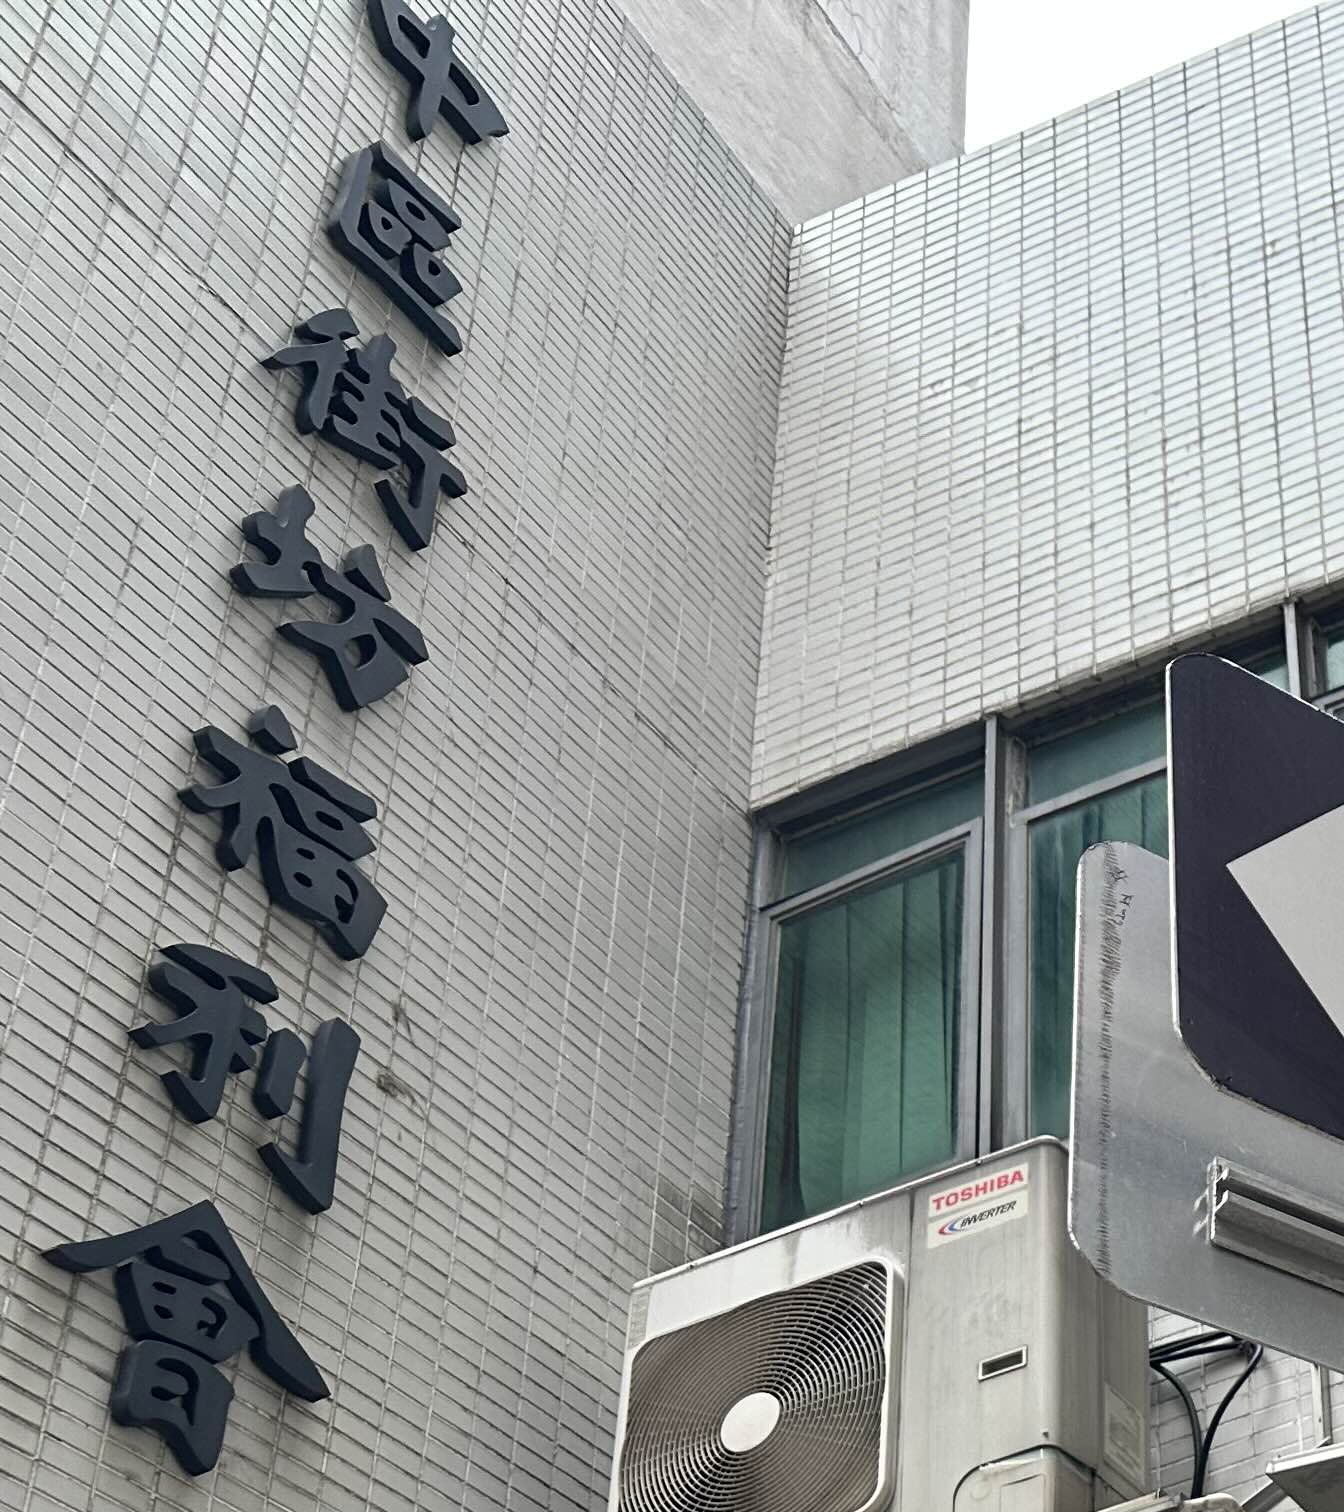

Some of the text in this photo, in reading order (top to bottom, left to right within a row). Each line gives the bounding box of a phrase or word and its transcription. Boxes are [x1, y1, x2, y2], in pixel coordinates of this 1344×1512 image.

[40, 0, 512, 1477] 中區街坊福利會
[932, 1170, 1025, 1211] TOSHIBA
[960, 1200, 1017, 1229] INVERTER
